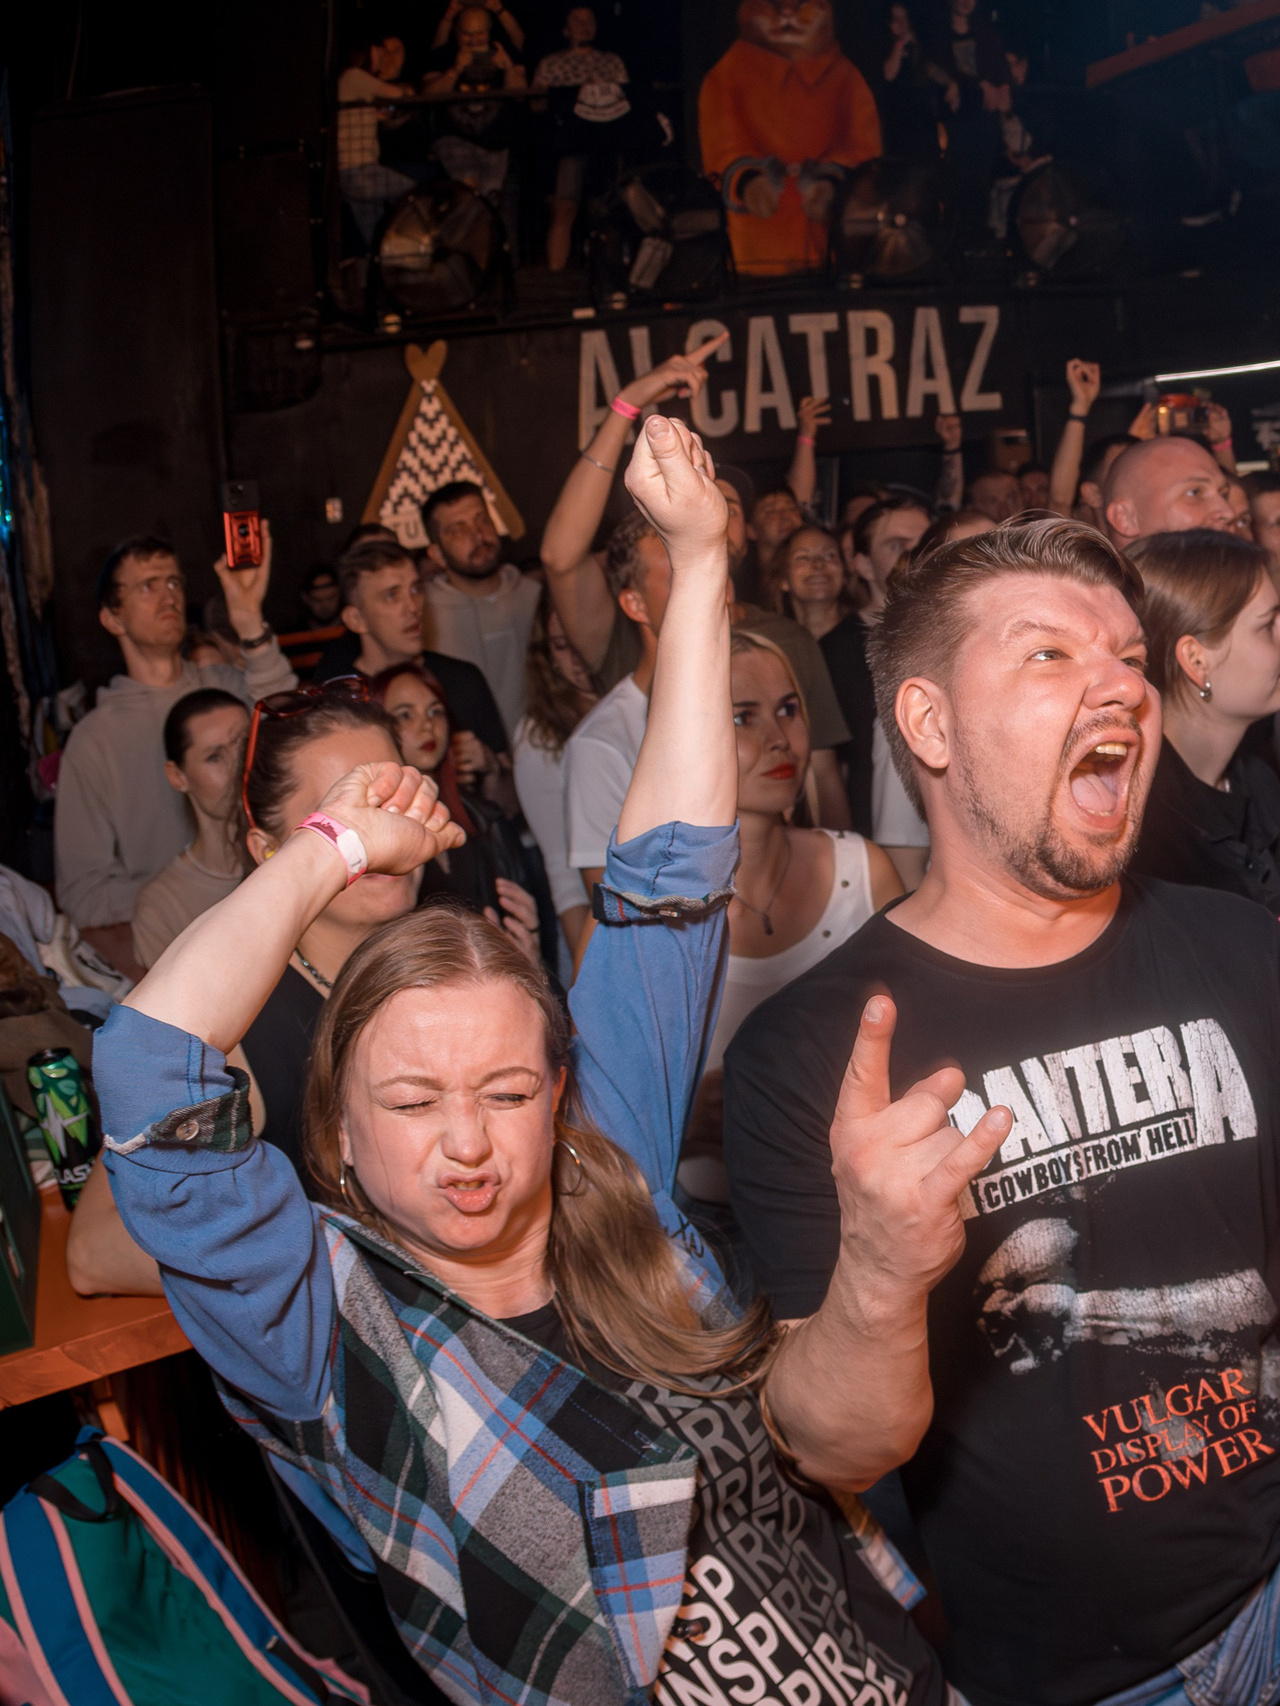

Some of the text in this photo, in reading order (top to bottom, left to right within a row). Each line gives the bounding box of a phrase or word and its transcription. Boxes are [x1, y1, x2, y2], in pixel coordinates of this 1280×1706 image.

[983, 1115, 1198, 1209] COWBOYS FROM HELL
[1082, 1368, 1252, 1441] VULGAR
[1090, 1400, 1257, 1475] DISPLAY OF
[1098, 1428, 1276, 1513] POWER
